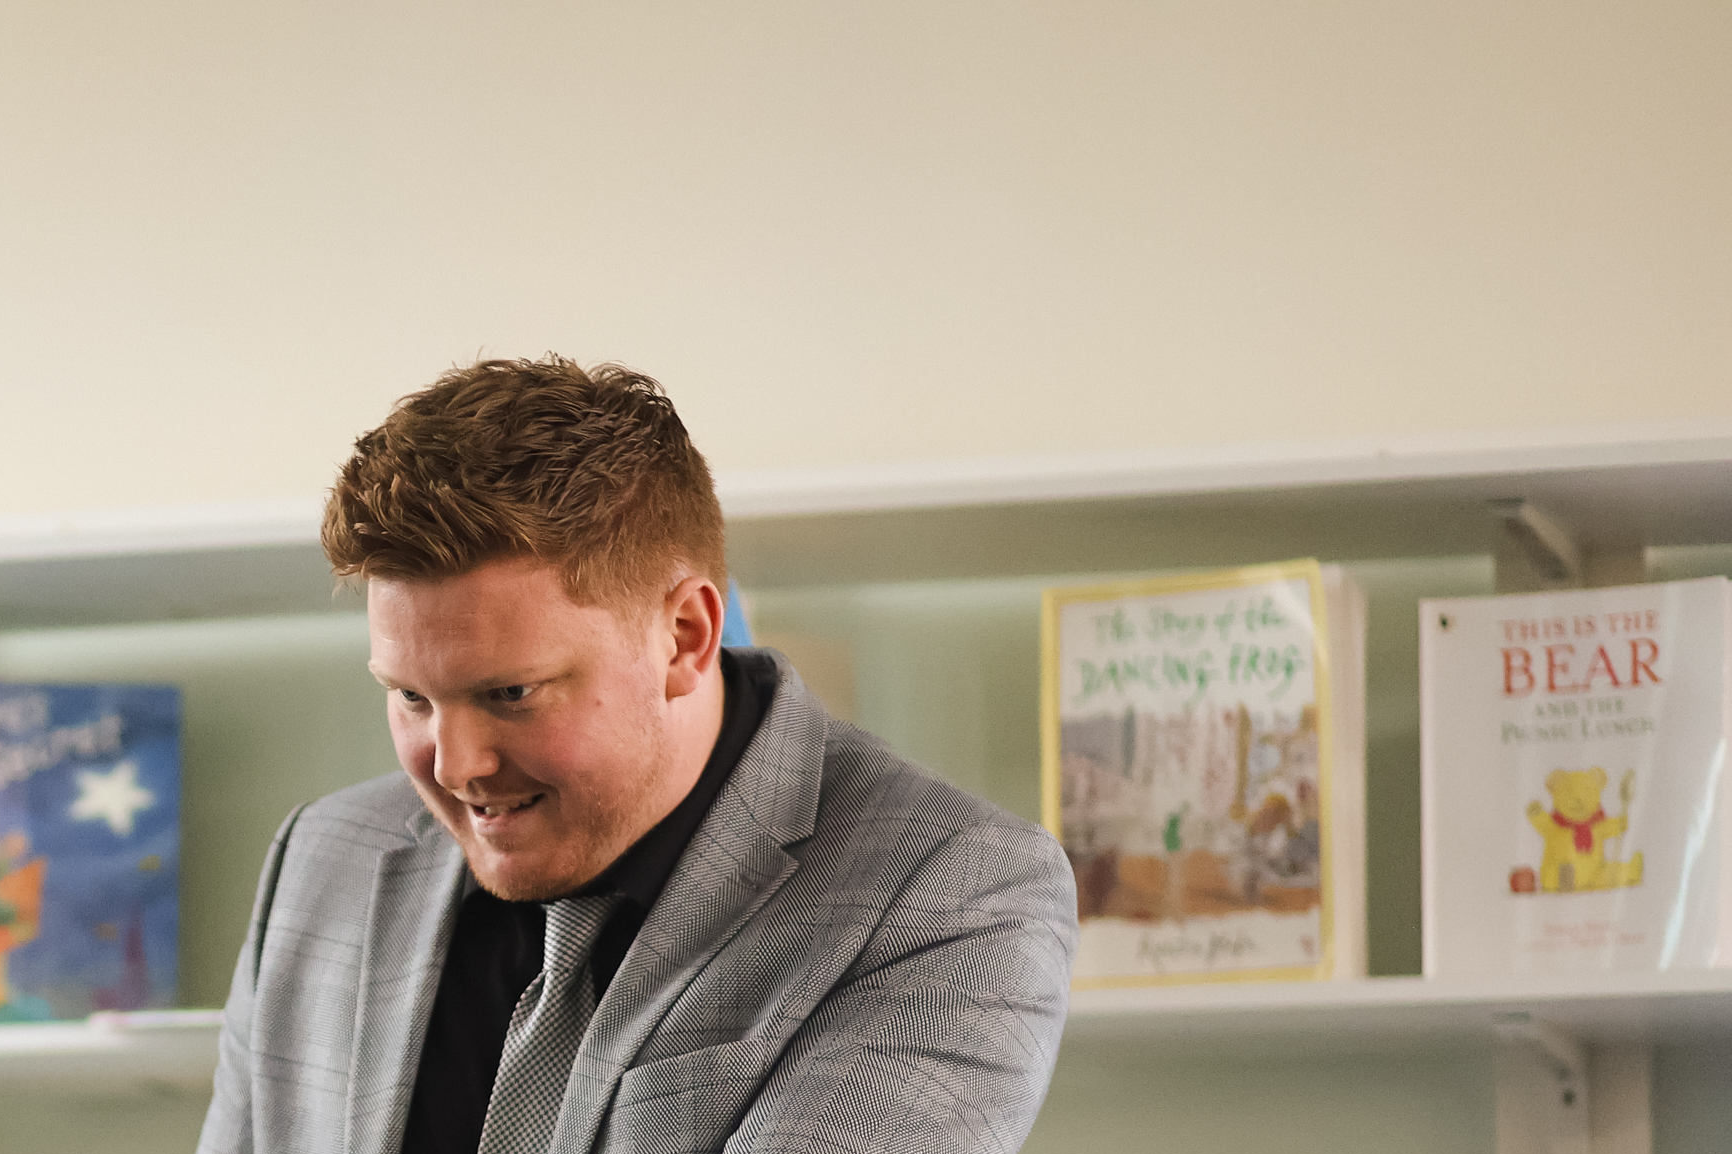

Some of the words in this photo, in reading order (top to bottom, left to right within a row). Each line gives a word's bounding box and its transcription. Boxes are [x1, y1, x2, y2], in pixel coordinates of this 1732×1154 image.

[1498, 617, 1567, 642] THIS
[1572, 614, 1598, 638] IS
[1607, 609, 1660, 635] THE
[1500, 636, 1662, 699] BEAR
